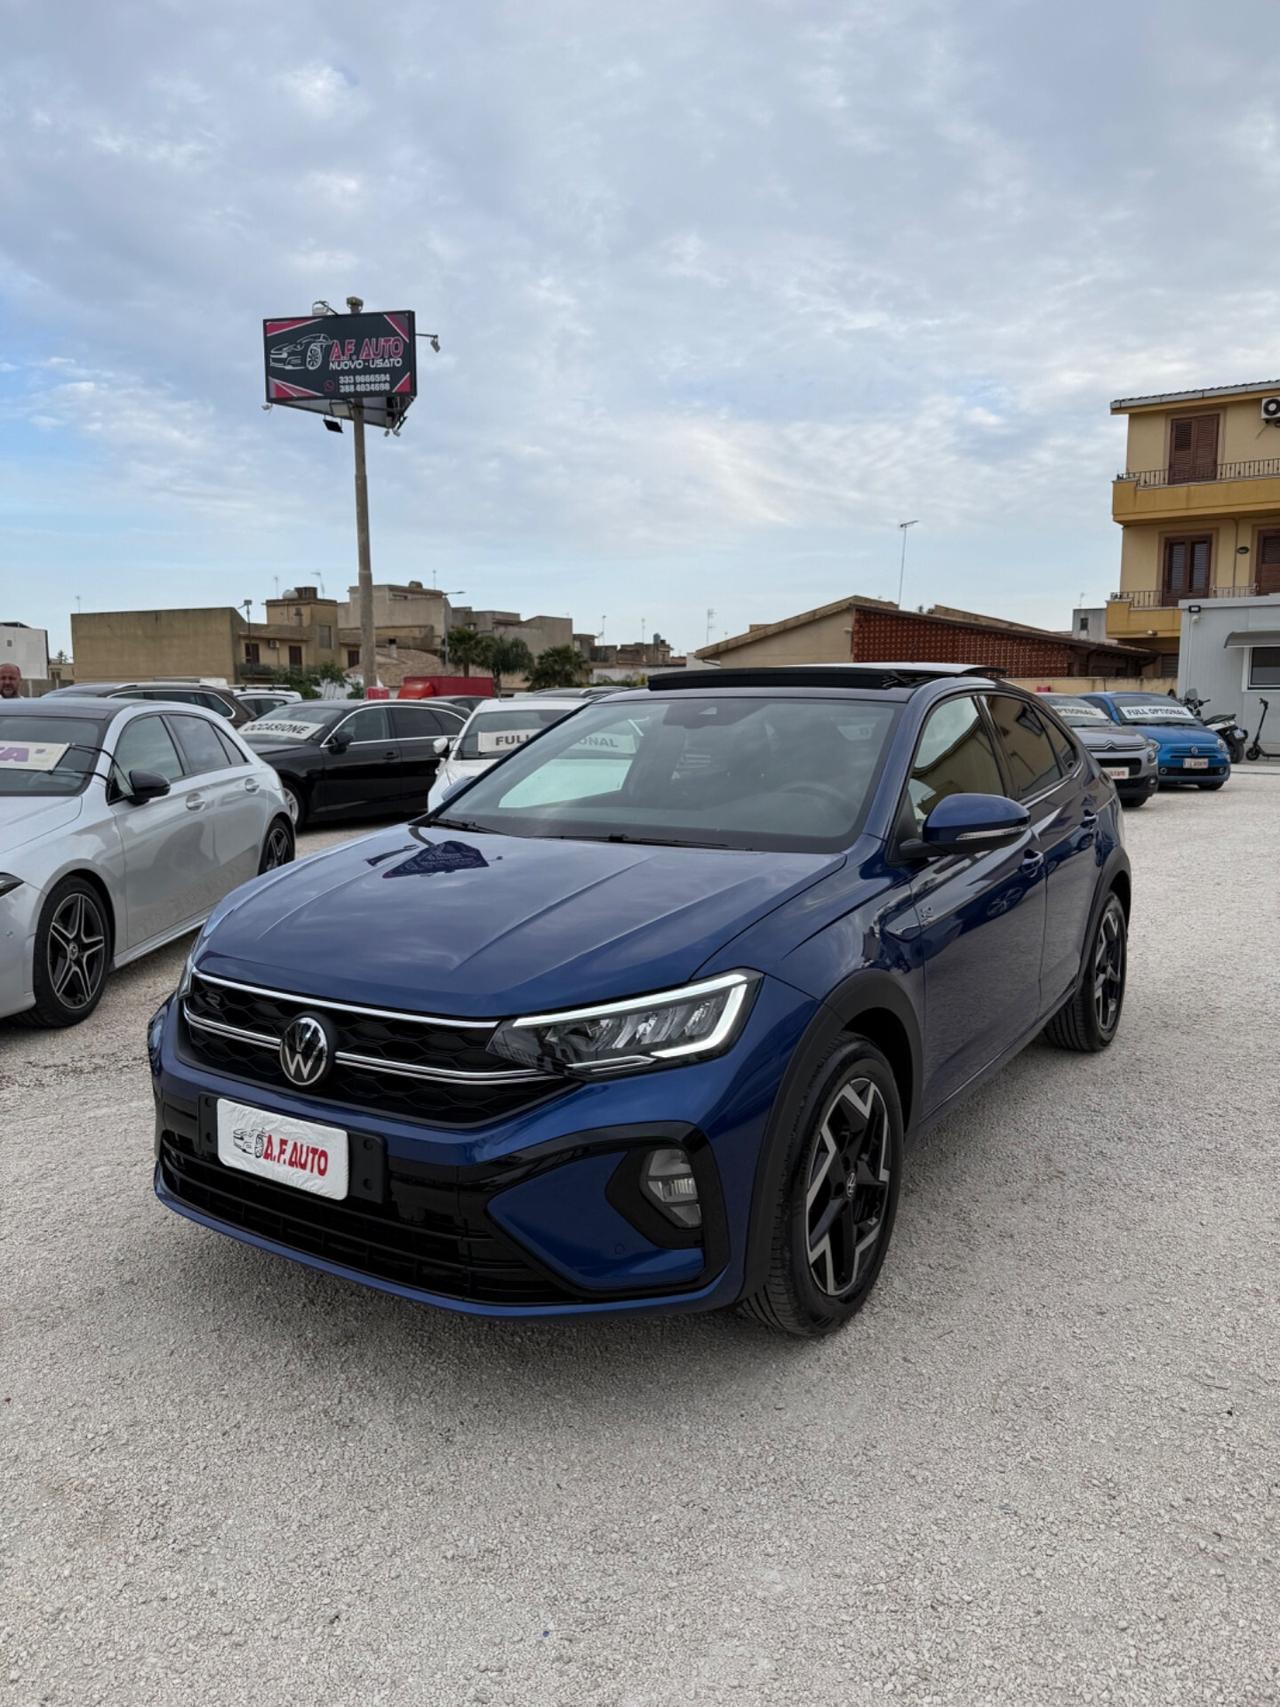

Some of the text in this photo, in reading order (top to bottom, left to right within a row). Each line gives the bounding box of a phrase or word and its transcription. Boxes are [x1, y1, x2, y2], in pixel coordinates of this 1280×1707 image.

[359, 336, 404, 360] AUTO
[329, 360, 364, 370] NUOVO
[369, 358, 403, 368] USATO
[243, 722, 310, 735] OCCASIONE
